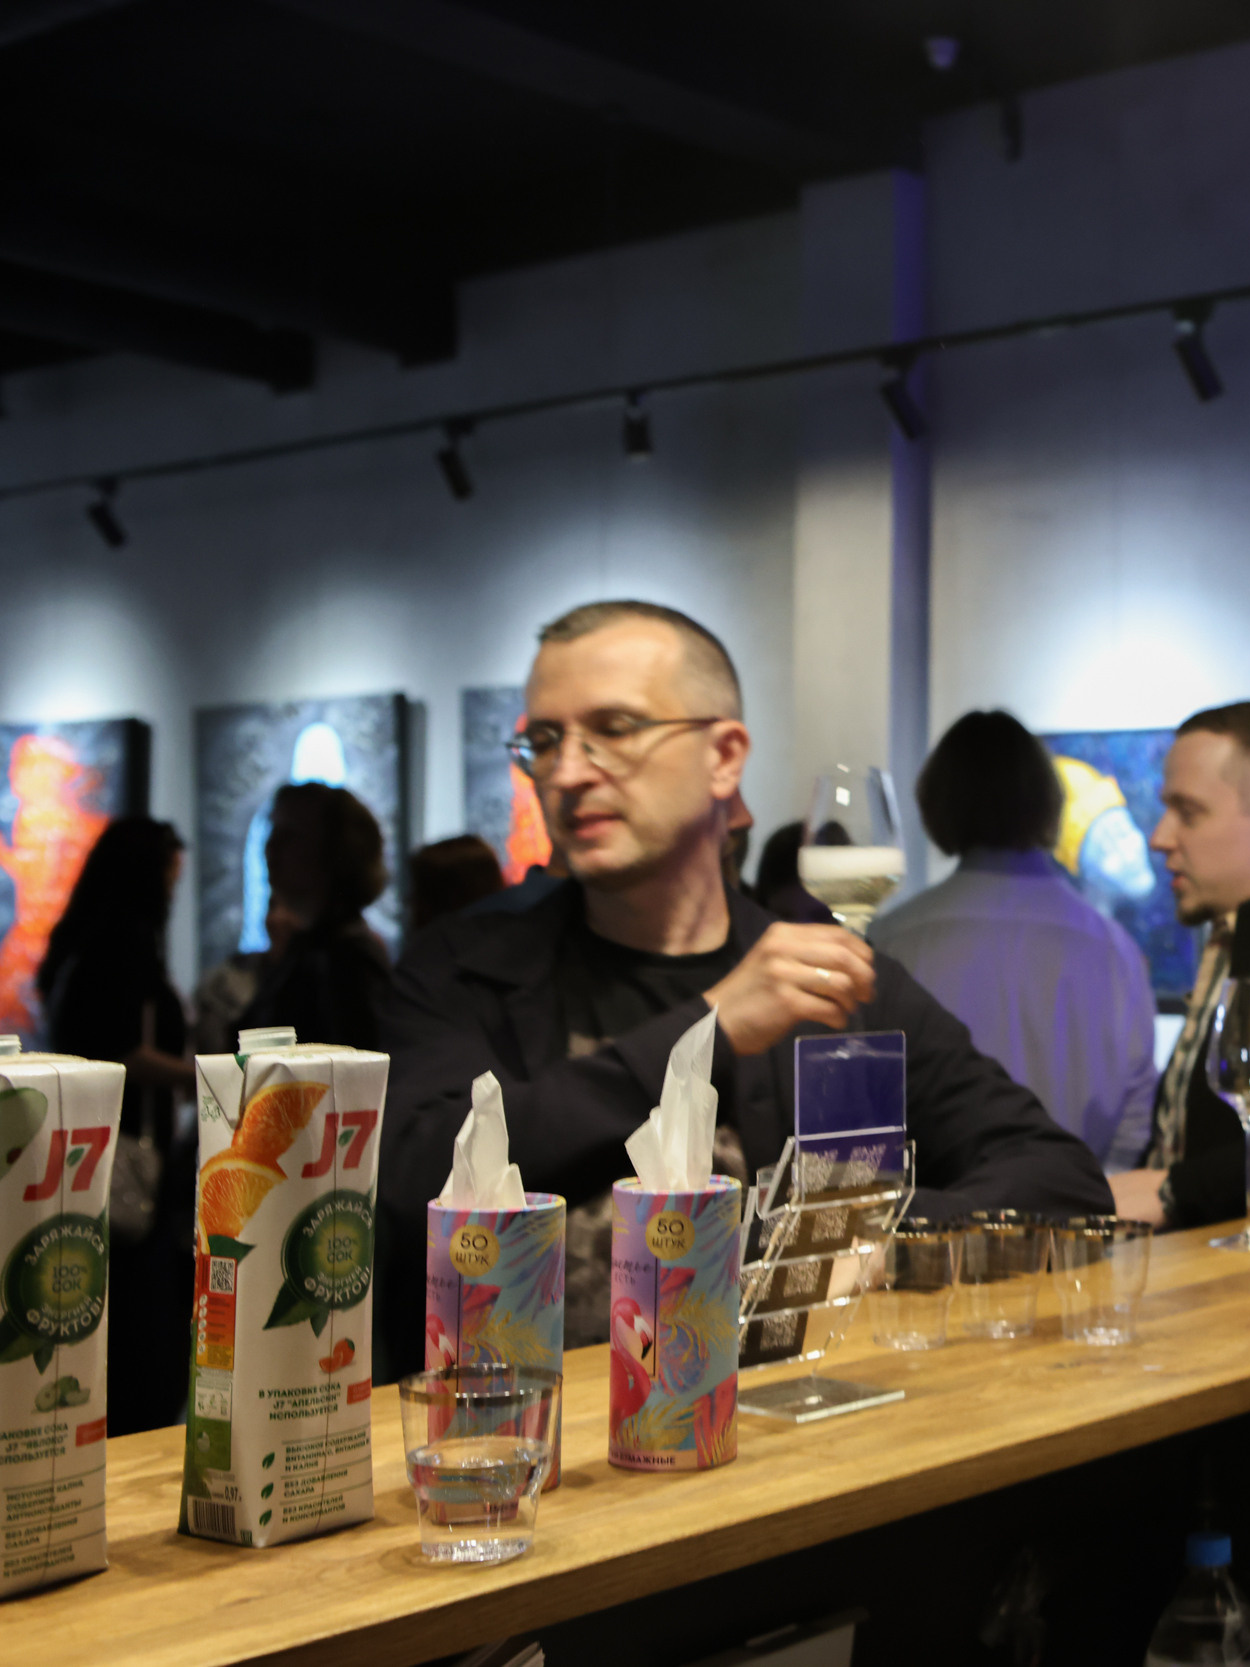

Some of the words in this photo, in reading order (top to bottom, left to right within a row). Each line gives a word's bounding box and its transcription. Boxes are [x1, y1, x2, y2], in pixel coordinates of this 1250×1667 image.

[301, 1109, 378, 1179] J7
[23, 1126, 111, 1202] J7
[303, 1200, 372, 1238] ЗАРЯЖАЙСЯ
[657, 1218, 685, 1236] 50
[24, 1224, 104, 1266] ЗАРЯЖАЙСЯ
[461, 1232, 489, 1251] 50
[652, 1236, 686, 1249] ШТУК
[327, 1250, 353, 1263] СОК
[456, 1251, 490, 1266] ШТУК
[52, 1279, 81, 1293] СОК
[259, 1389, 265, 1399] В
[267, 1385, 318, 1398] УПАКОВКЕ
[319, 1382, 341, 1393] СОКА
[288, 1392, 341, 1408] "АПЕЛЬСИН"
[269, 1404, 338, 1421] ИСПОЛЬЗУЕТСЯ
[44, 1422, 68, 1435] СОКА
[284, 1480, 298, 1489] БЕЗ
[300, 1468, 348, 1485] ДОБАВЛЕНИЯ
[284, 1486, 315, 1498] САХАРА
